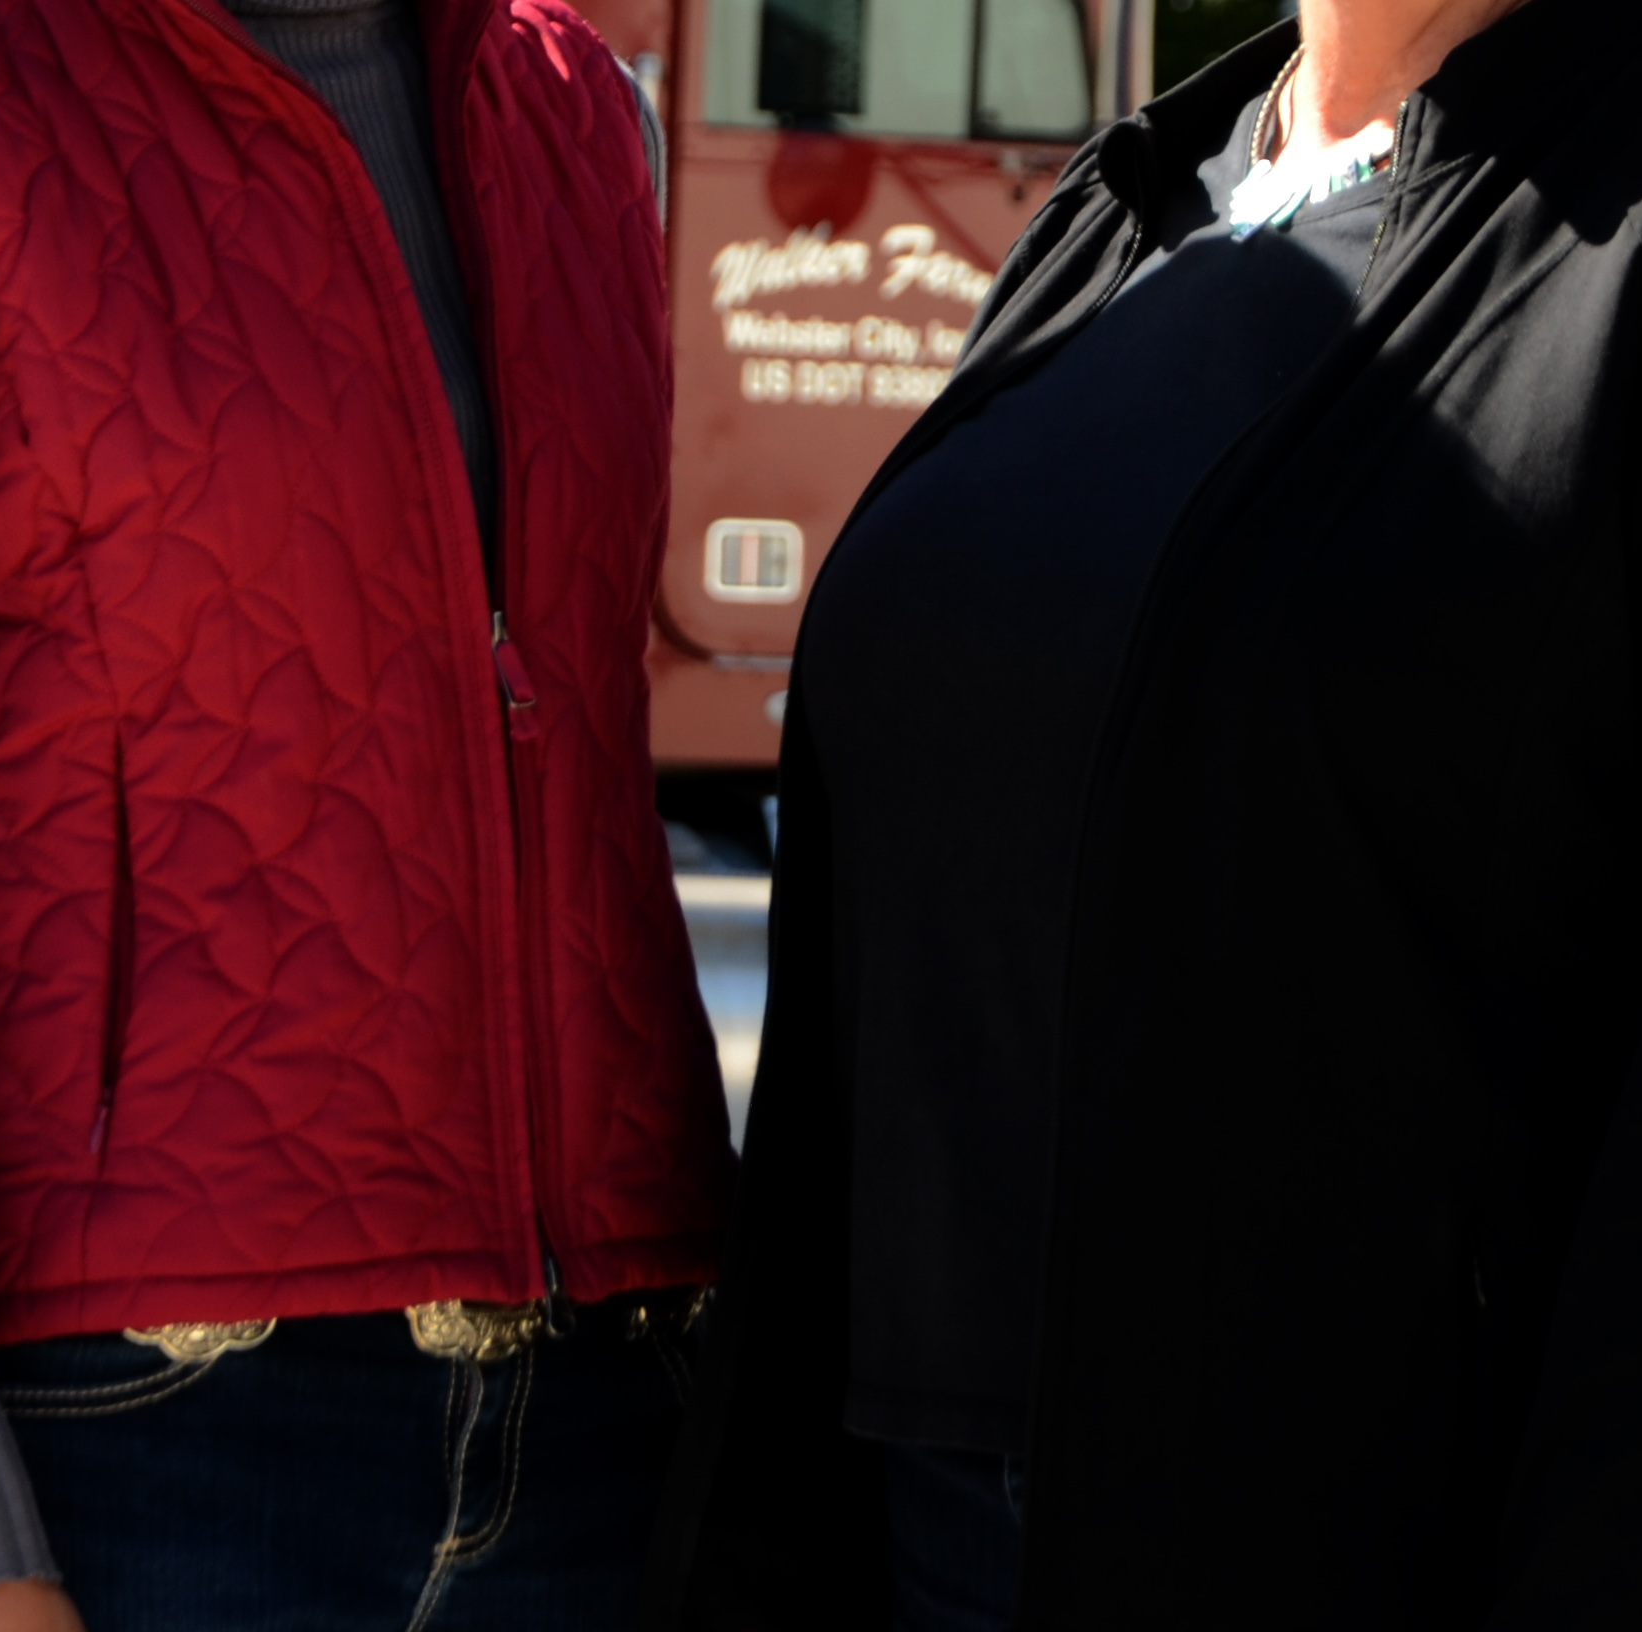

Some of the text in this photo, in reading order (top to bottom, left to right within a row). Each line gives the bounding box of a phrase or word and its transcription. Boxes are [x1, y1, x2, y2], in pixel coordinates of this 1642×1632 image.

[724, 310, 851, 356] Webster
[926, 320, 966, 364] Io
[741, 358, 792, 403] US
[794, 359, 865, 406] DOT
